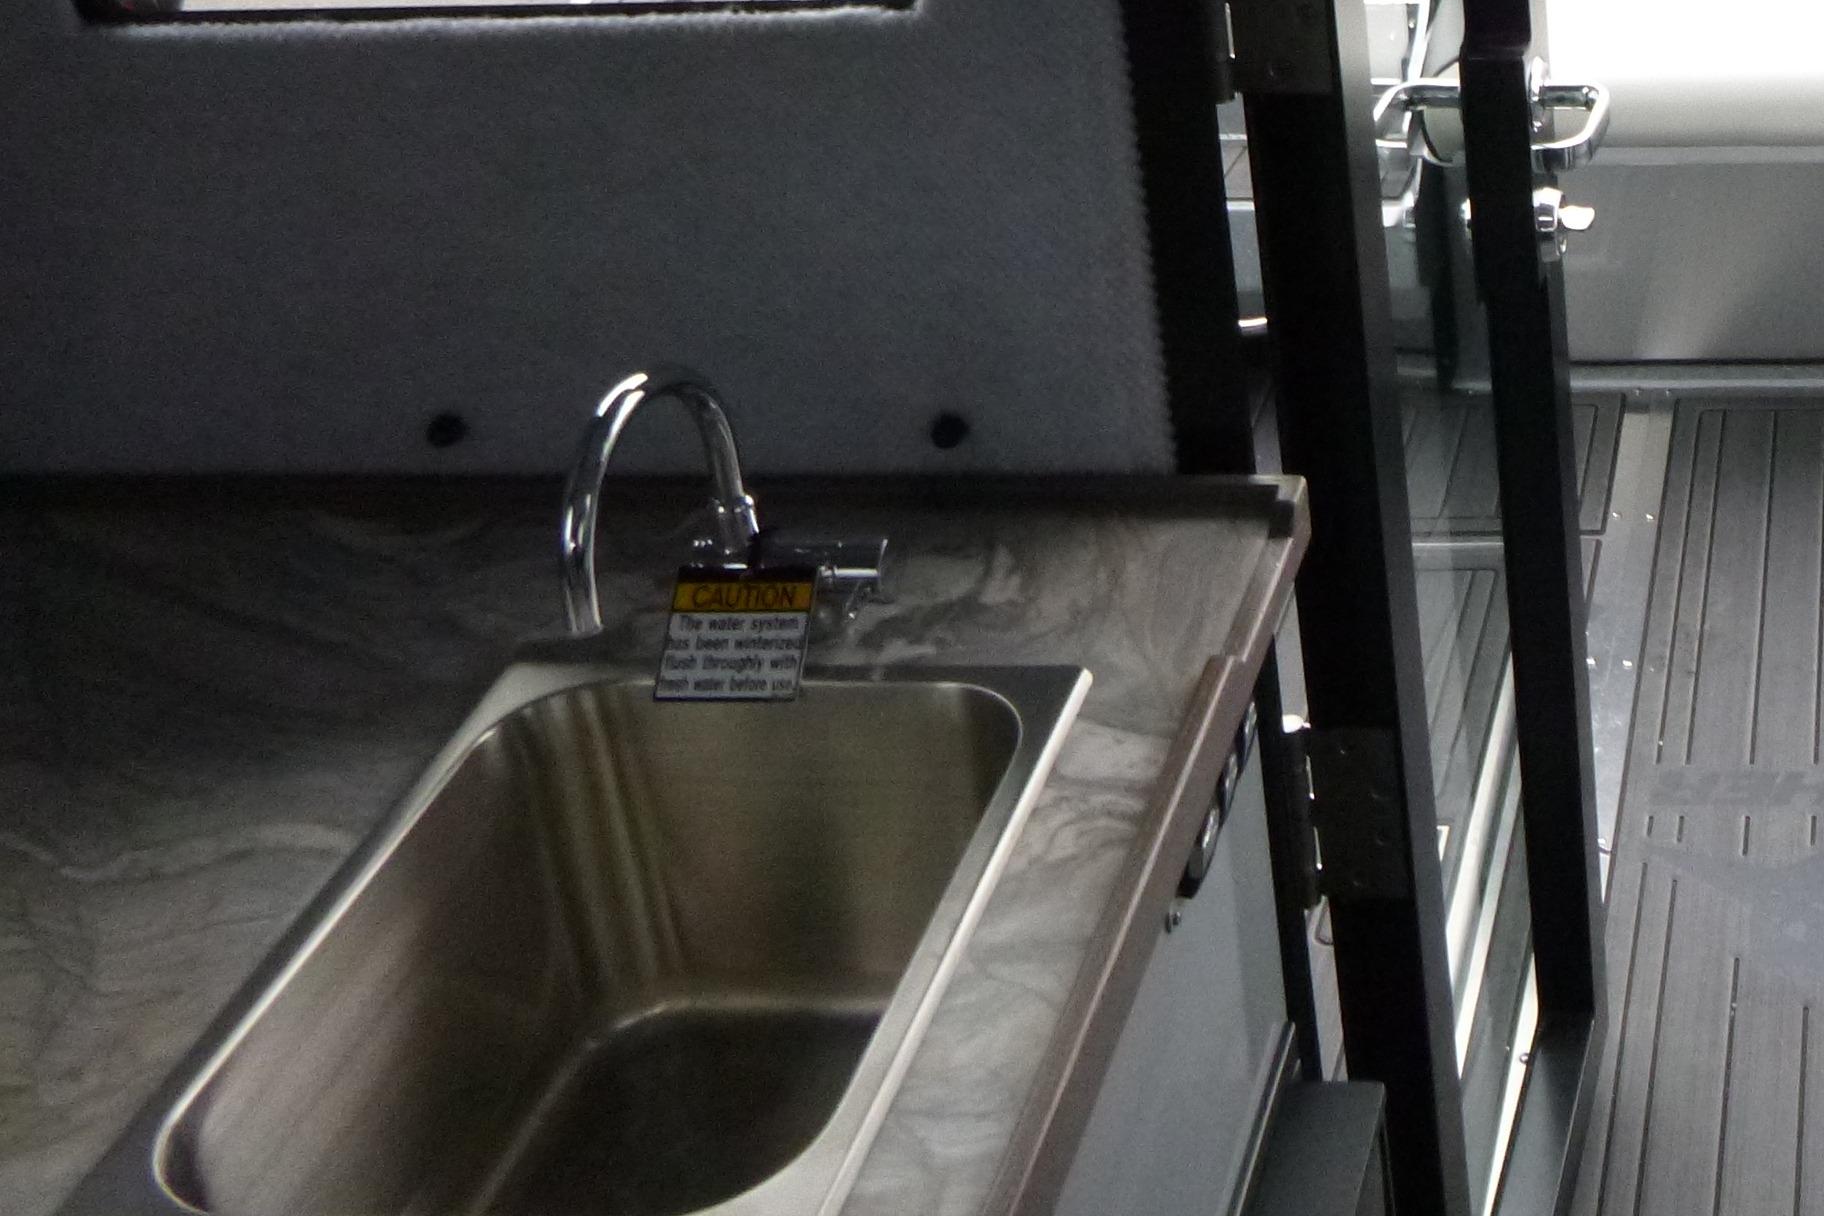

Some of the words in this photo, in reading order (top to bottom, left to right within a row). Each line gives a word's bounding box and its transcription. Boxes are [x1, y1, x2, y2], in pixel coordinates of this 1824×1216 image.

[693, 585, 797, 608] CAUTION
[681, 615, 703, 631] The
[708, 617, 745, 631] water
[751, 616, 799, 634] system
